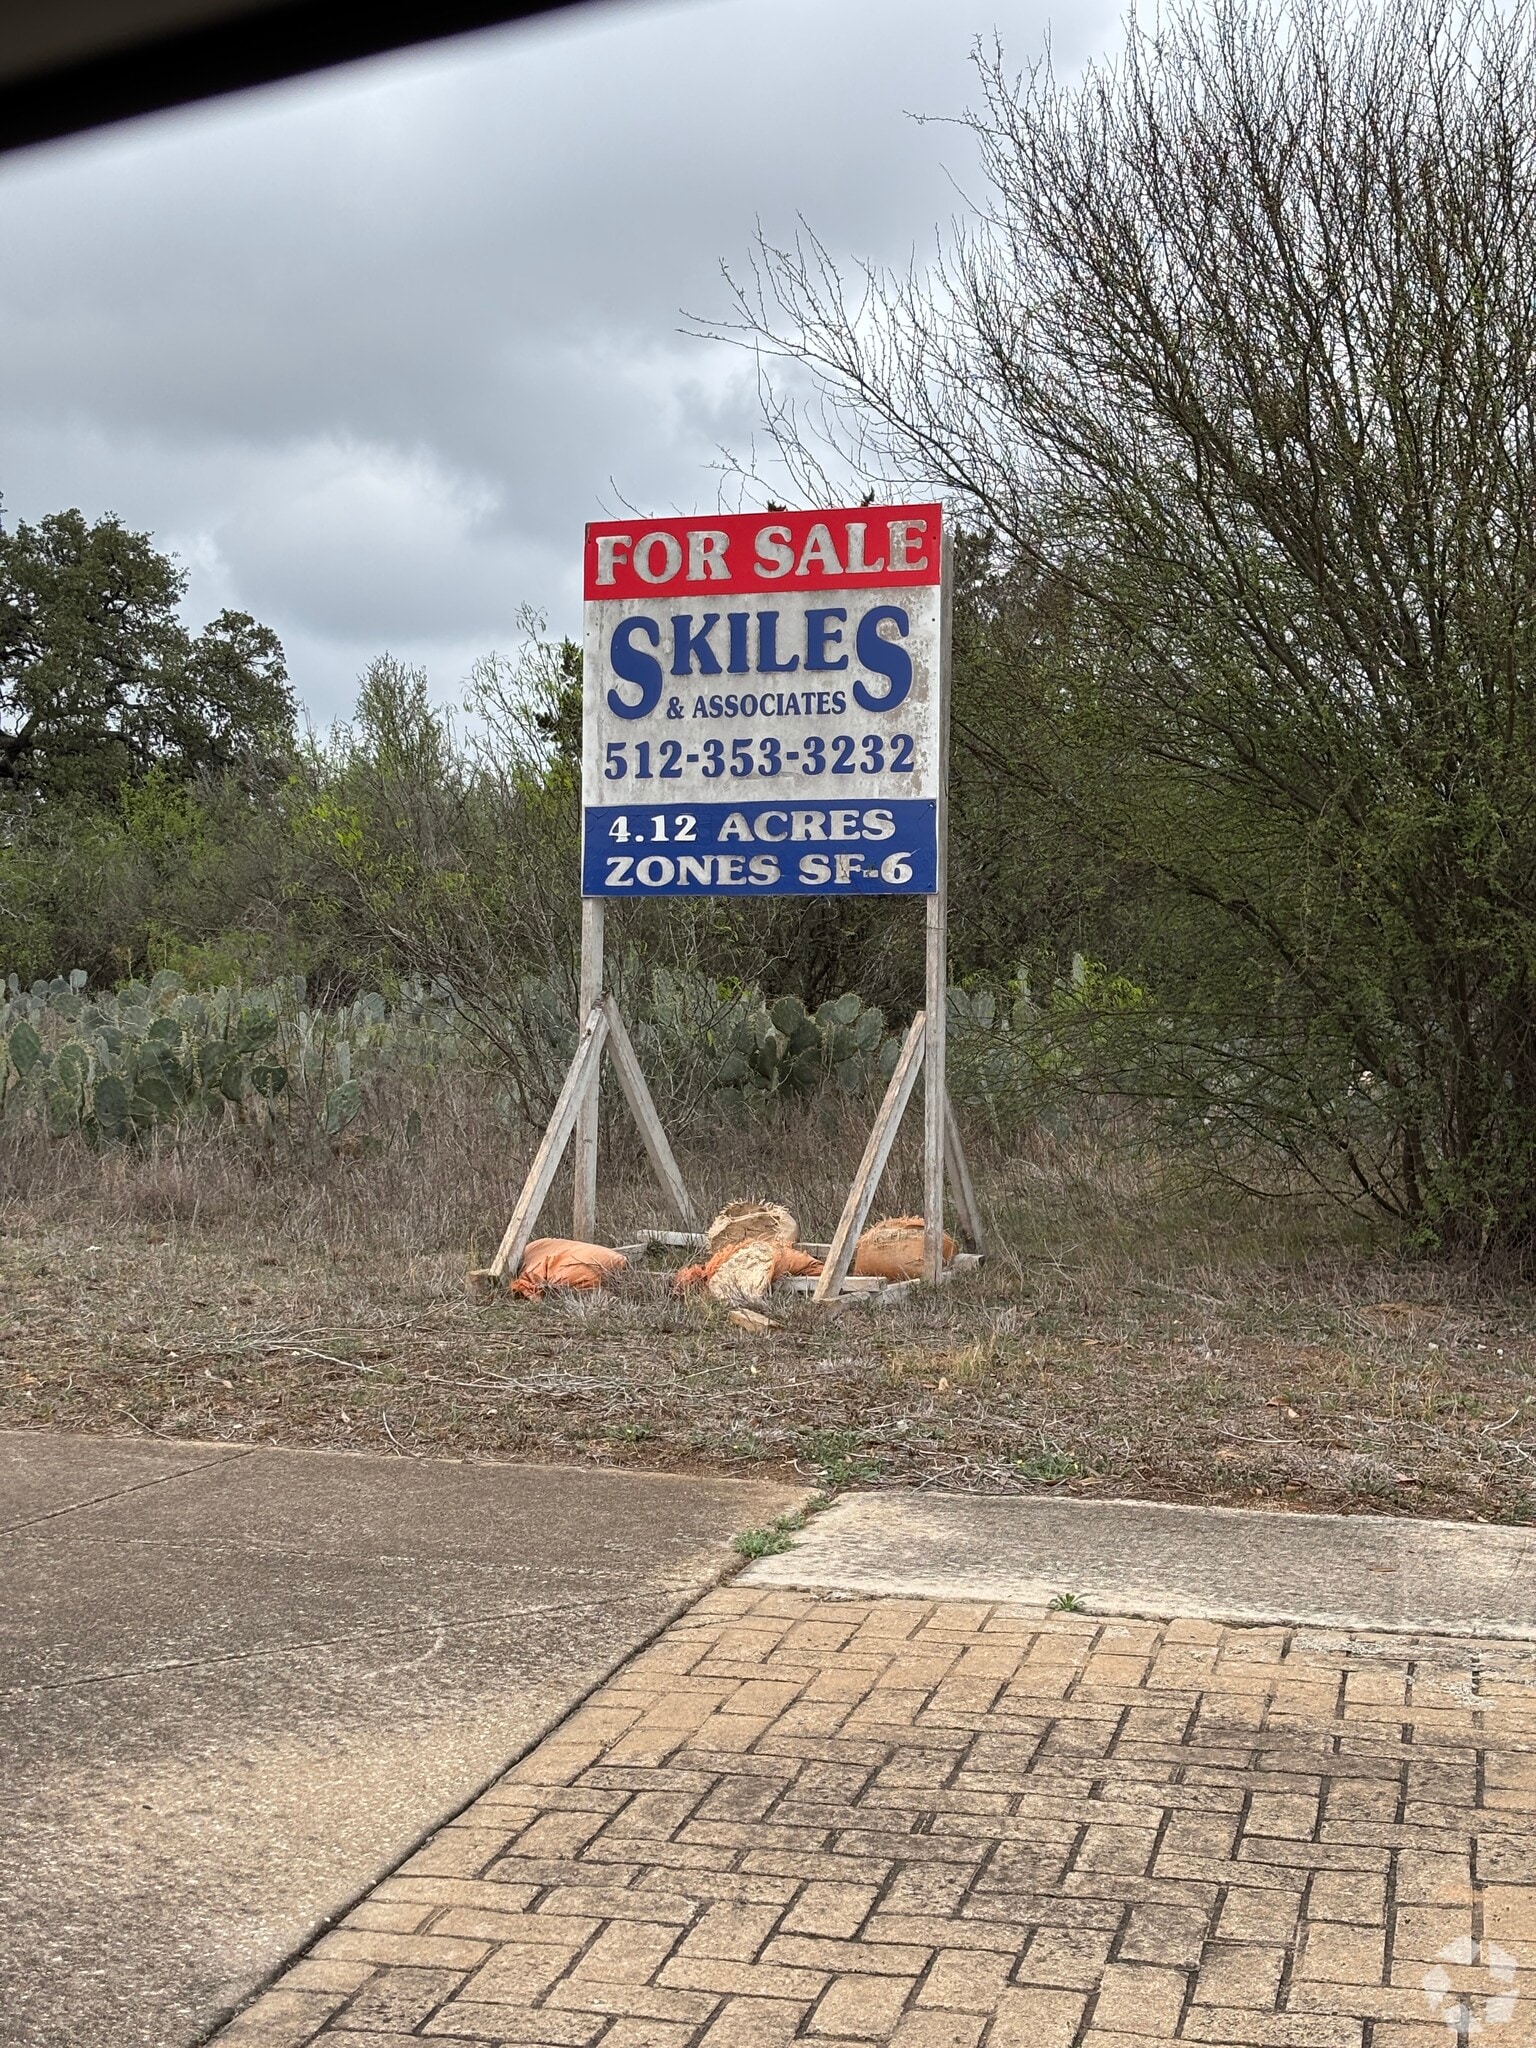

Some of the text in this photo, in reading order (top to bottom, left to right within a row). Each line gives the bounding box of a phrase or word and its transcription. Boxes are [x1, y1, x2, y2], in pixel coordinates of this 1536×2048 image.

[595, 519, 928, 585] FOR SALE
[607, 605, 913, 720] SKILES
[667, 691, 847, 719] & ASSOCIATES
[604, 733, 915, 780] 512-353-3232
[608, 809, 896, 843] 4.12 ACRES
[604, 851, 914, 887] ZONES SF-6
